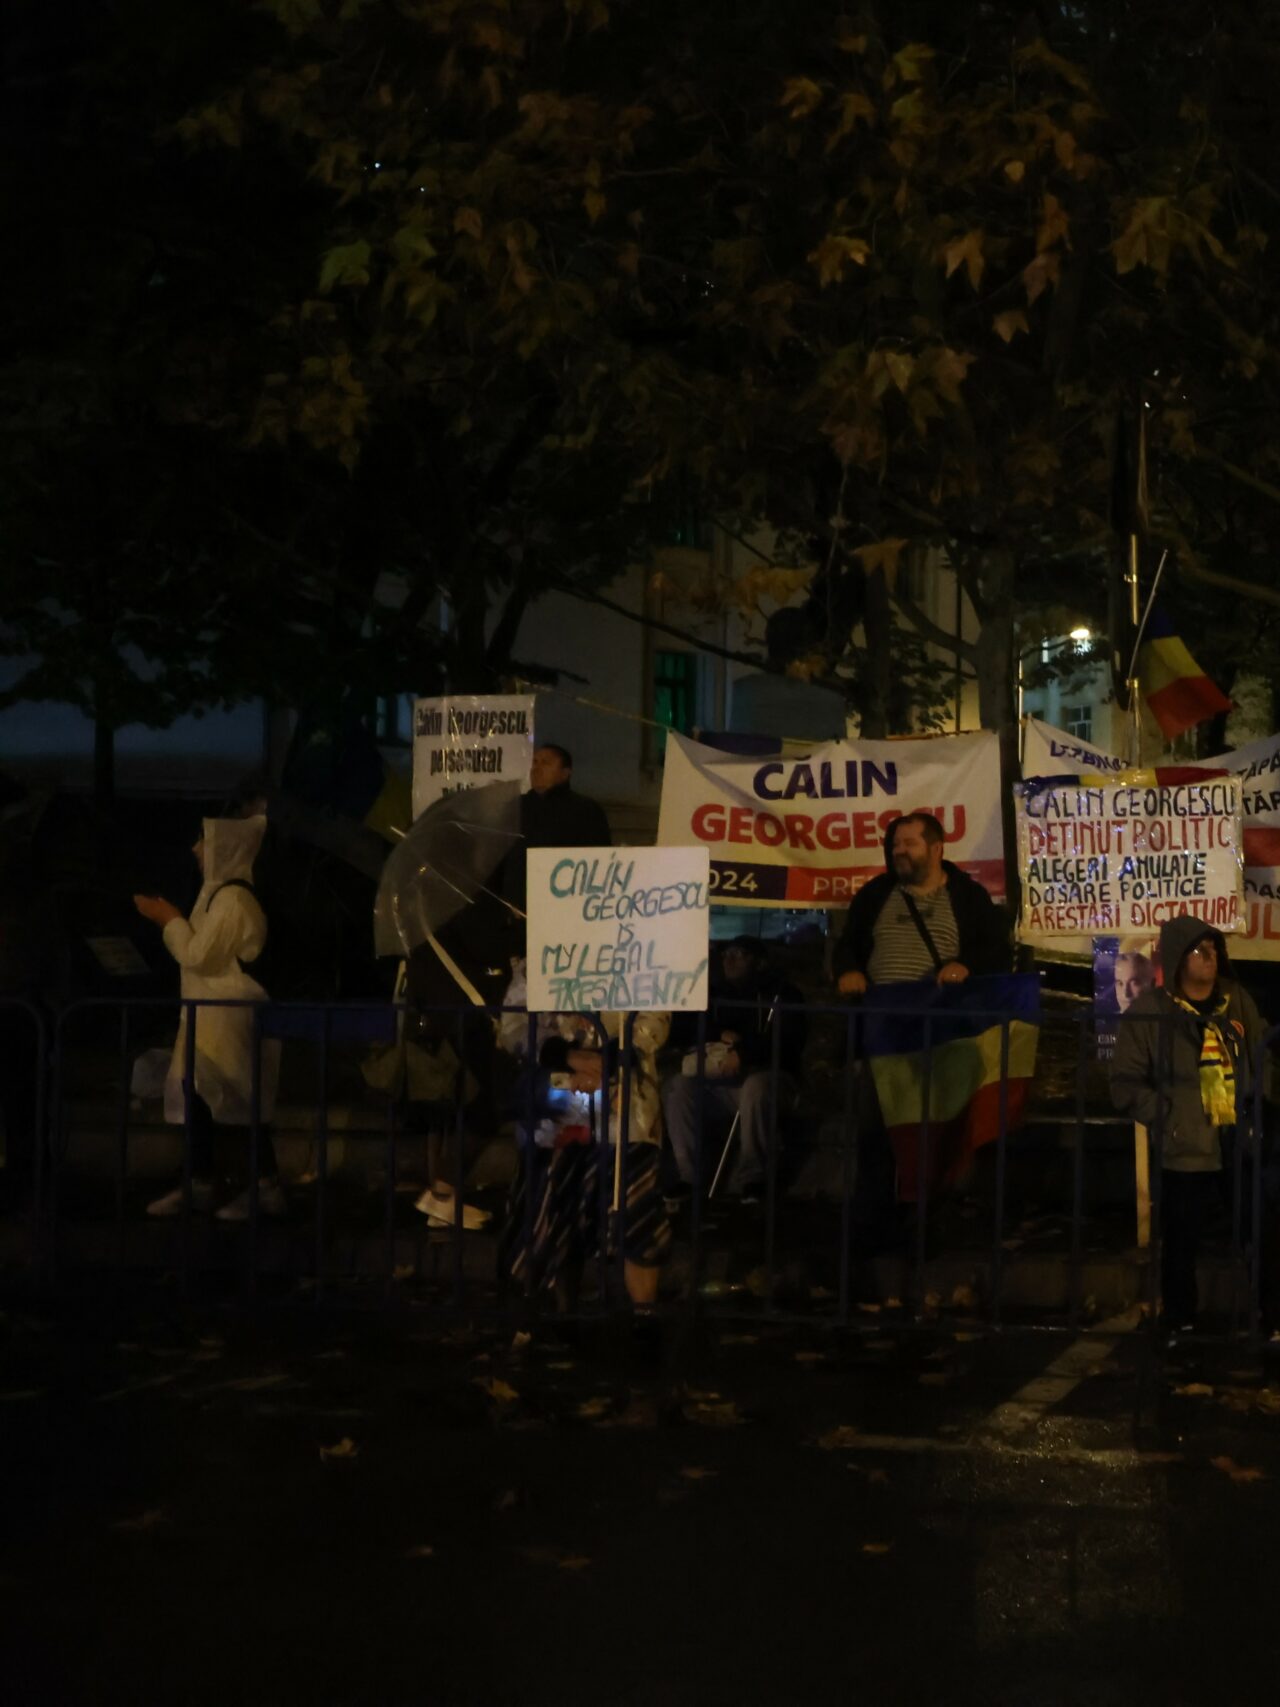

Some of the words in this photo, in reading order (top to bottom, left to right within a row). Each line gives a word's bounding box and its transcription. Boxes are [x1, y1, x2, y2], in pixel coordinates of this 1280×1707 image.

[753, 754, 898, 801] CĂLIN
[1112, 784, 1235, 818] GEORGESCU
[691, 804, 966, 851] GEORGESU
[1132, 815, 1232, 853] POLITIC
[1028, 856, 1108, 884] ALEGERI
[1029, 882, 1111, 906] DOSARE
[1120, 877, 1206, 901] POLITICE
